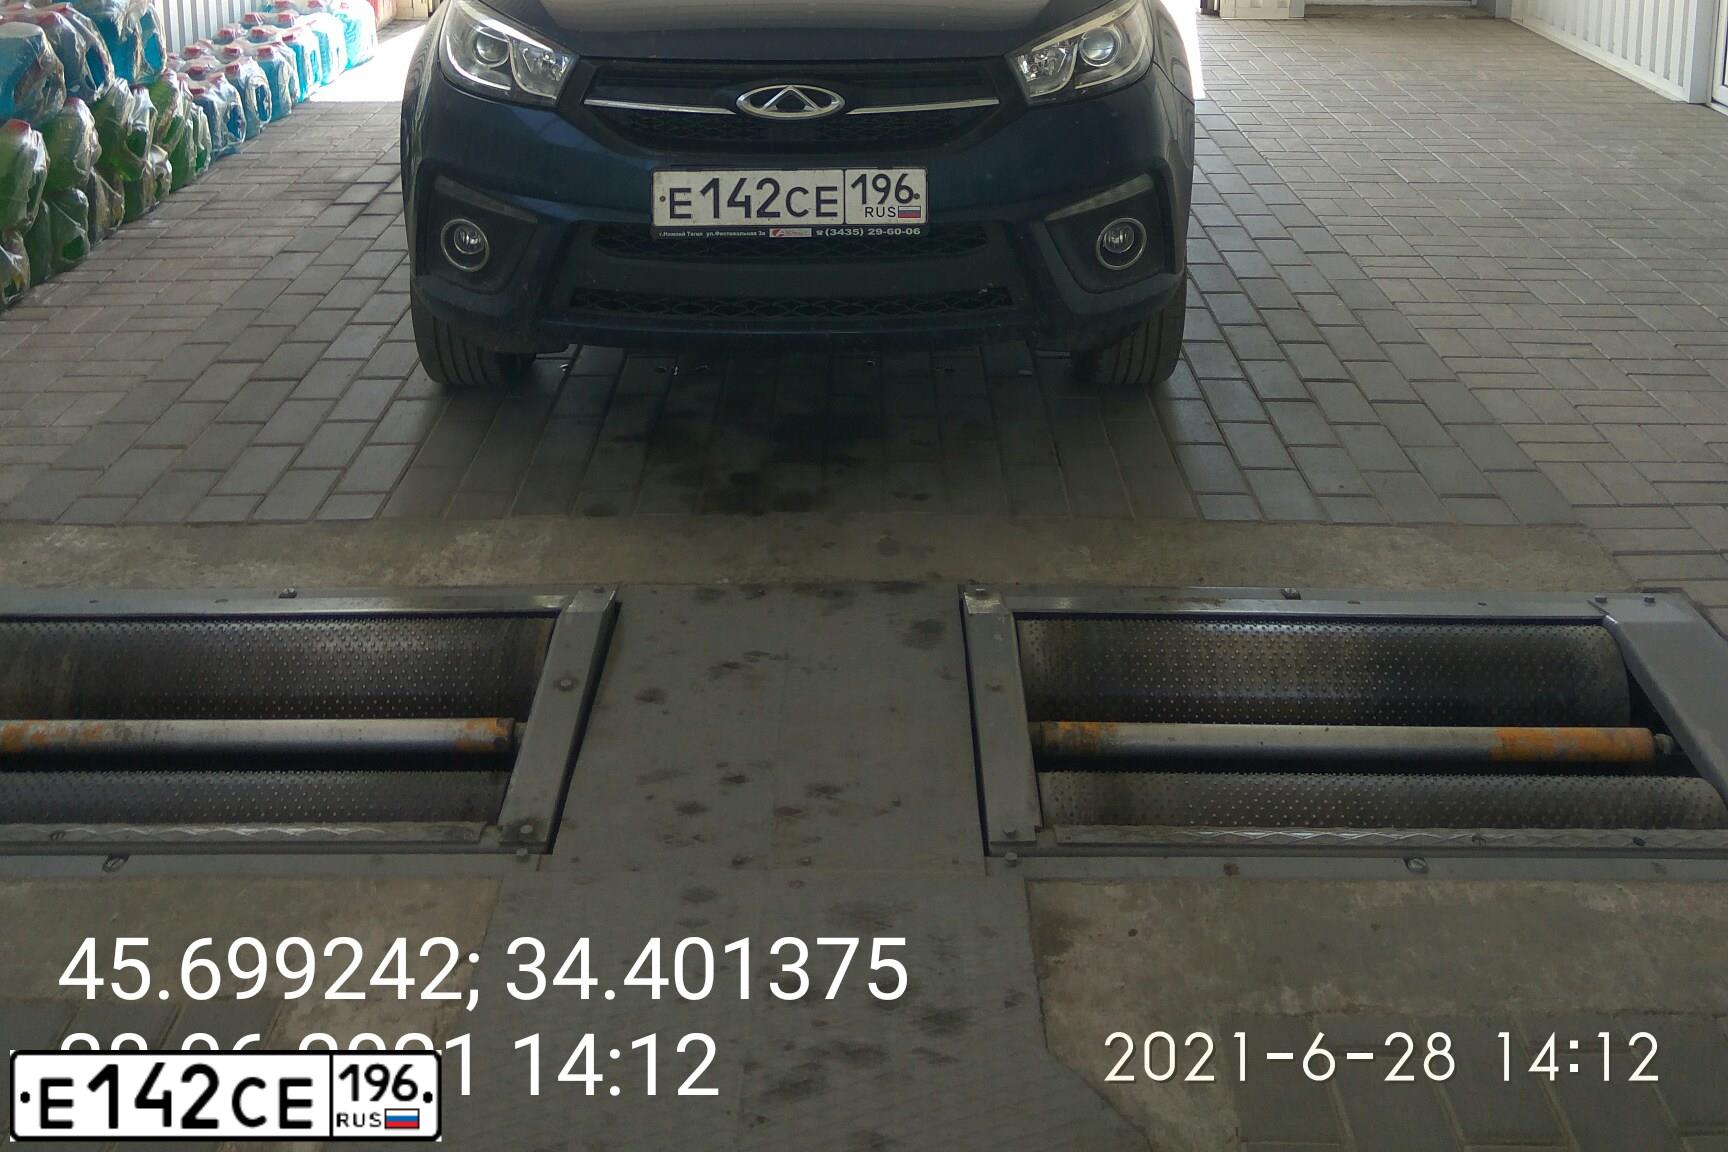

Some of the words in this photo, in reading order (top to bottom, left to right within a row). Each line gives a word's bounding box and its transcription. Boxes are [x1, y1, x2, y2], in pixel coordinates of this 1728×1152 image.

[851, 173, 915, 205] 196
[864, 206, 896, 218] RUS
[825, 227, 864, 237] (3435)
[867, 227, 921, 236] 29-60-06
